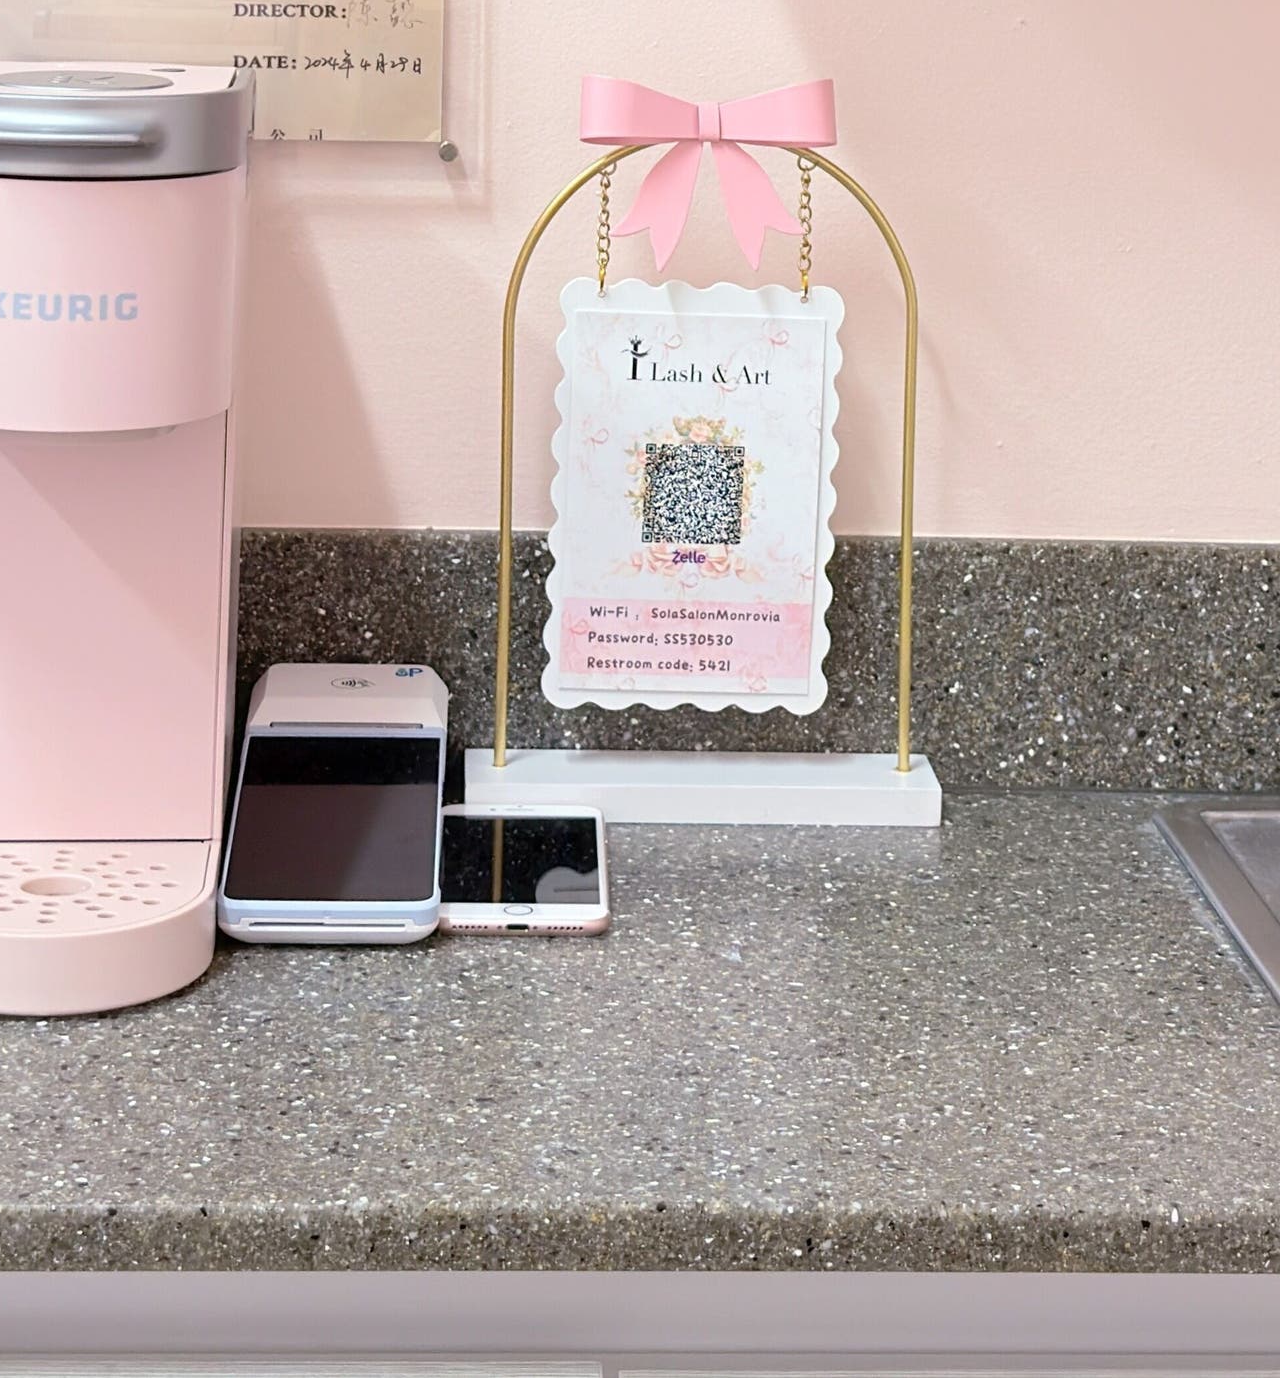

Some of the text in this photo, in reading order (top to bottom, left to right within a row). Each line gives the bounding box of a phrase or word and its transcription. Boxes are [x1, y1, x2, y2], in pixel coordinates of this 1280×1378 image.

[234, 2, 347, 19] DIRECTOR:
[233, 54, 296, 70] DATE:
[650, 362, 703, 383] Lash
[711, 365, 728, 384] &
[735, 365, 773, 385] Art
[671, 549, 706, 565] Zelle
[590, 606, 628, 618] Wi-Fi
[651, 608, 781, 622] SolaSalonMonrovia
[588, 631, 733, 646] Password: SS530530
[587, 656, 731, 672] Restroom code: 5421
